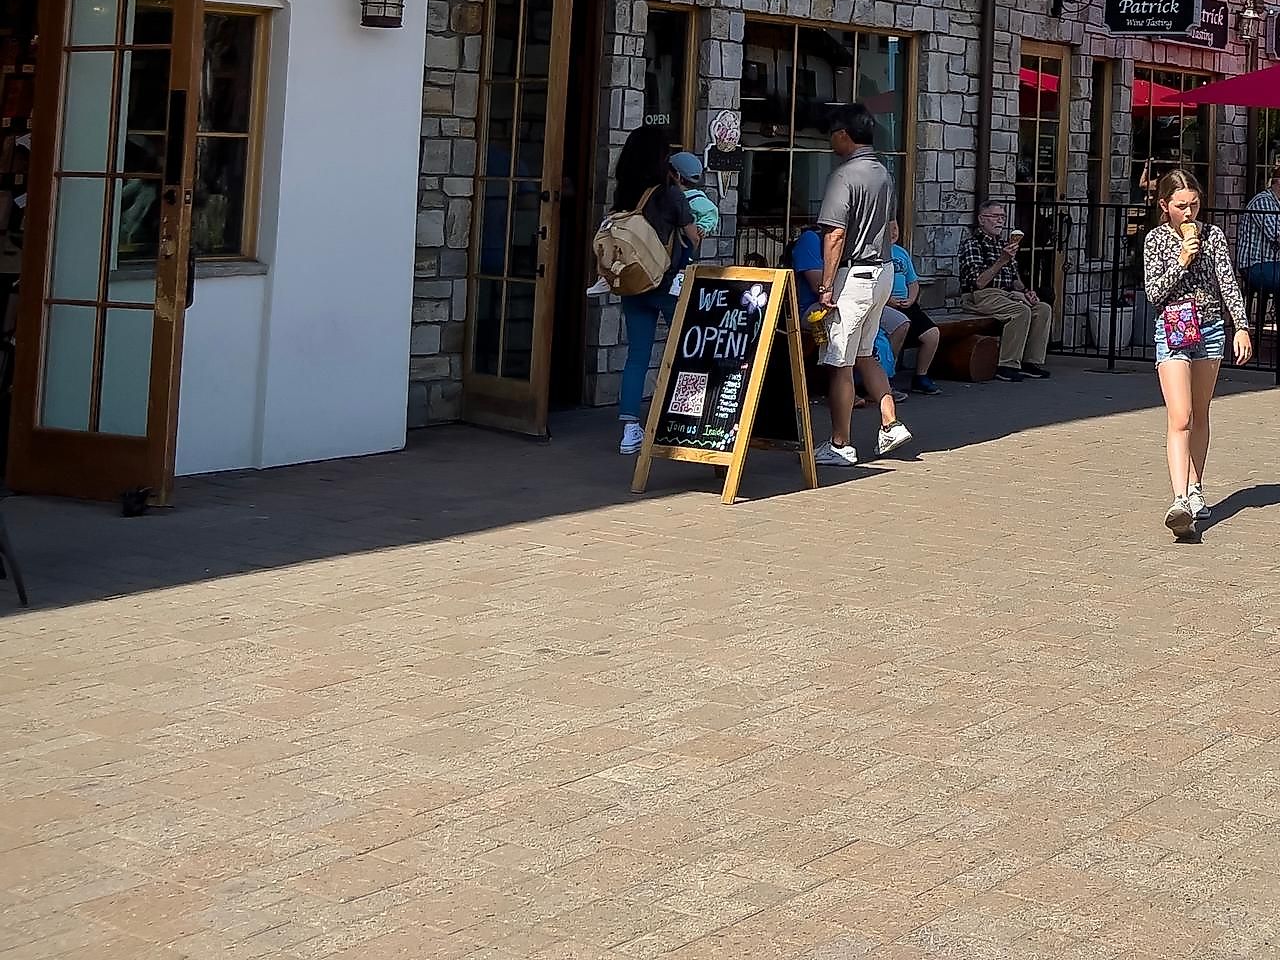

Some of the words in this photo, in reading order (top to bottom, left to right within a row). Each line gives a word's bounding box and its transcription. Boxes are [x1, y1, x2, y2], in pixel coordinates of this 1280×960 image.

[1126, 18, 1143, 26] Wine
[1145, 17, 1172, 30] Tasting
[1201, 7, 1225, 25] trick
[645, 114, 670, 125] OPEN
[699, 287, 729, 311] WE
[719, 309, 748, 330] ARE
[683, 325, 748, 359] OPEN!
[666, 421, 685, 433] Join
[687, 425, 697, 435] us
